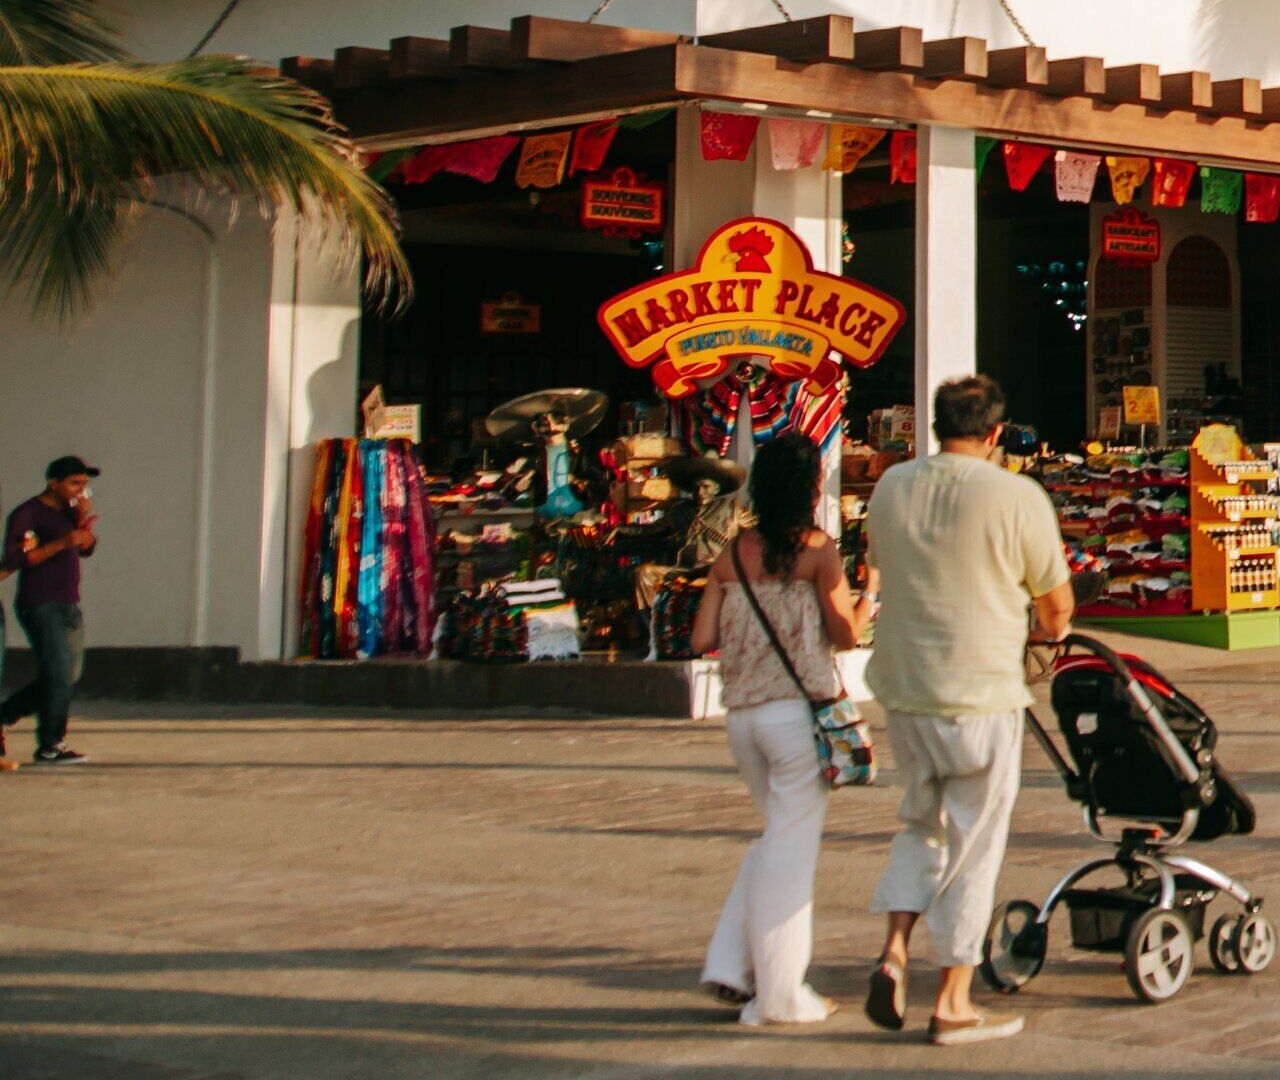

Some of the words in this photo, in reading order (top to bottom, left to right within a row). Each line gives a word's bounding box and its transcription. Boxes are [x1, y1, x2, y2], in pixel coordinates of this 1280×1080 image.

[611, 279, 762, 348] MARKET
[774, 280, 887, 349] PLACE
[679, 329, 736, 357] PUERTO
[738, 325, 814, 357] VALLARTA
